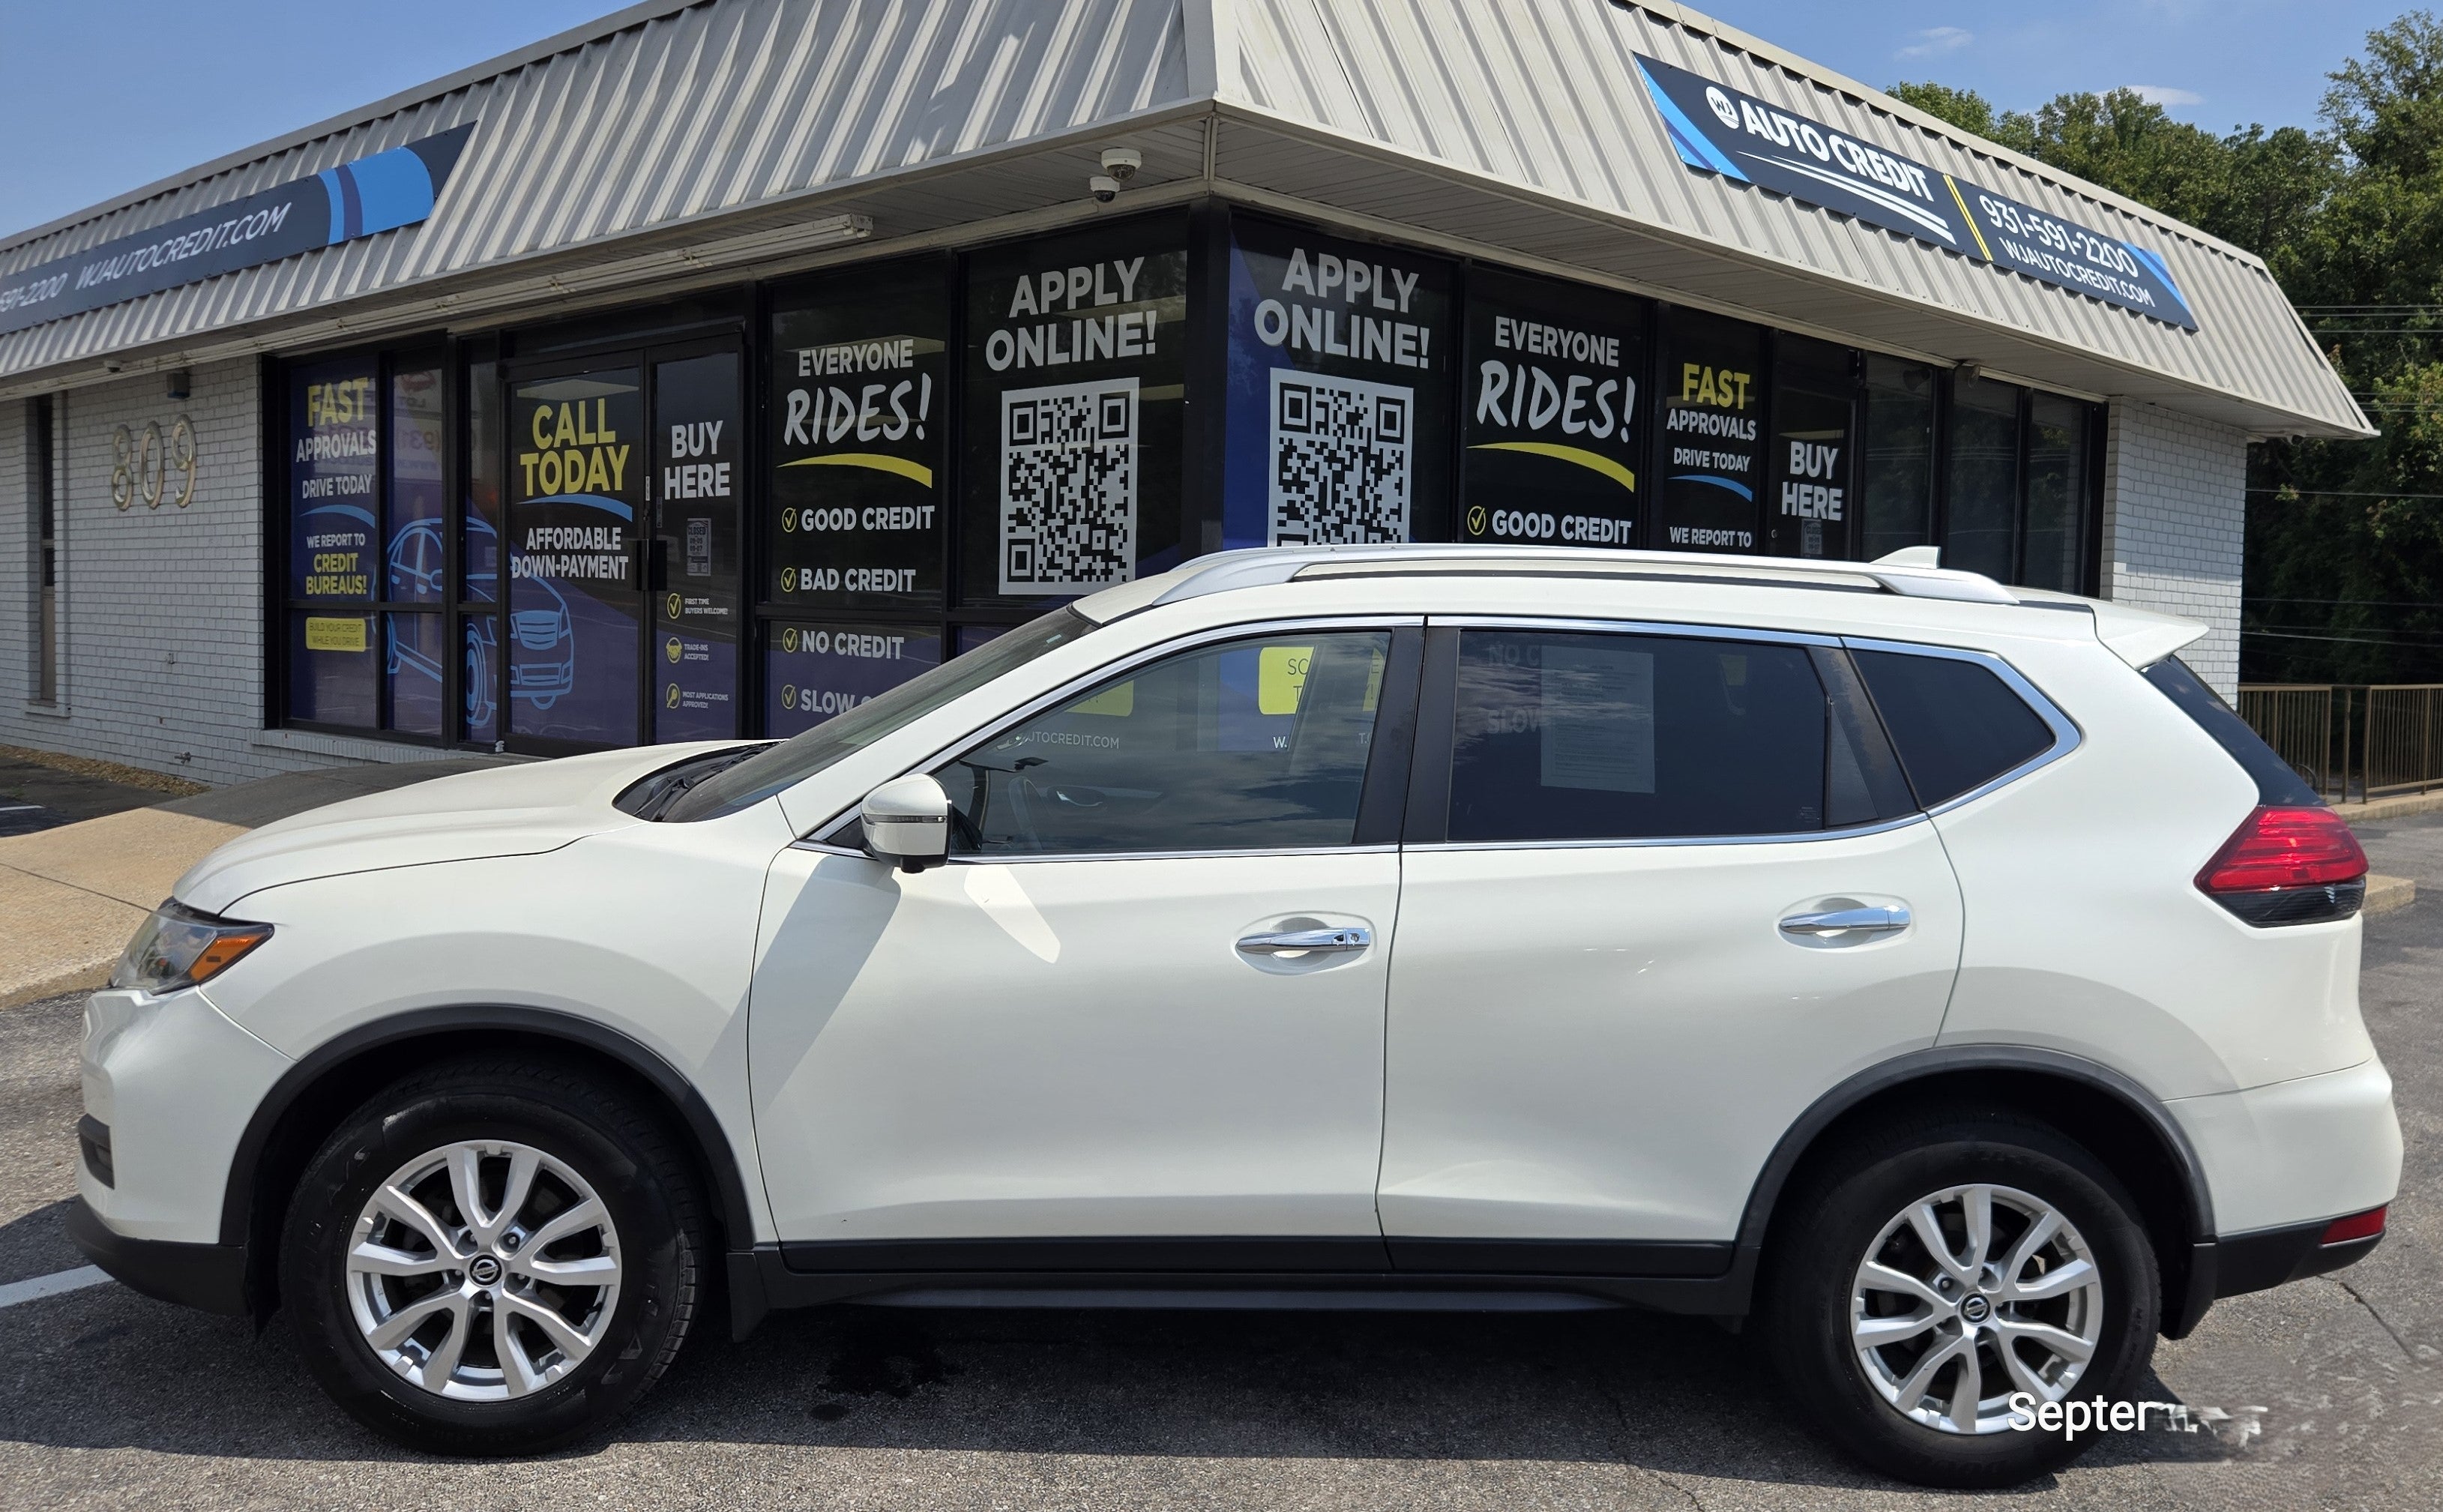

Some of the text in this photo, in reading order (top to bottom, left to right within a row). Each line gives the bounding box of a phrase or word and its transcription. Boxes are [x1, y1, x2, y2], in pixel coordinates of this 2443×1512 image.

[1739, 99, 1831, 163] AUTO
[1828, 133, 1935, 202] CREDIT
[75, 202, 292, 290] WJAUTOCREDIT.COM
[1978, 193, 2140, 278] 931-591-2200
[1009, 257, 1145, 318] APPLY
[1282, 247, 1419, 313] APPLY
[1998, 236, 2155, 308] WJAUTOCREDIT.COM
[985, 310, 1157, 371] ONLINE!
[1254, 299, 1430, 369] ONLINE!
[1495, 316, 1619, 367] EVERYONE
[798, 340, 914, 377] EVERYONE
[307, 377, 368, 427] FAST
[1476, 360, 1636, 443] RIDES!
[1682, 363, 1750, 410] FAST
[532, 398, 615, 450] CALL
[783, 373, 932, 445] RIDES!
[1666, 409, 1756, 441] APPROVALS
[296, 430, 376, 463] APPROVALS
[672, 421, 723, 458] BUY
[111, 414, 197, 511] 809
[520, 445, 630, 496] TODAY
[1673, 448, 1750, 473] DRIVE TODAY
[1789, 442, 1838, 480] BUY
[302, 474, 372, 499] DRIVE TODAY
[665, 463, 730, 500] HERE
[801, 505, 935, 532] GOOD CREDIT
[1781, 481, 1843, 521] HERE
[307, 533, 366, 549] WE REPORT TO
[525, 527, 621, 551] AFFORDABLE
[1492, 509, 1632, 545] GOOD CREDIT
[1669, 526, 1752, 548] WE REPORT TO
[313, 552, 358, 573] CREDIT
[512, 555, 628, 579] DOWN-PAYMENT
[801, 568, 916, 592] BAD CREDIT
[306, 575, 367, 595] BUREAUS!
[802, 630, 904, 660] NO CREDIT
[801, 688, 855, 714] SLOW
[1028, 731, 1120, 749] UTOCREDIT.COM
